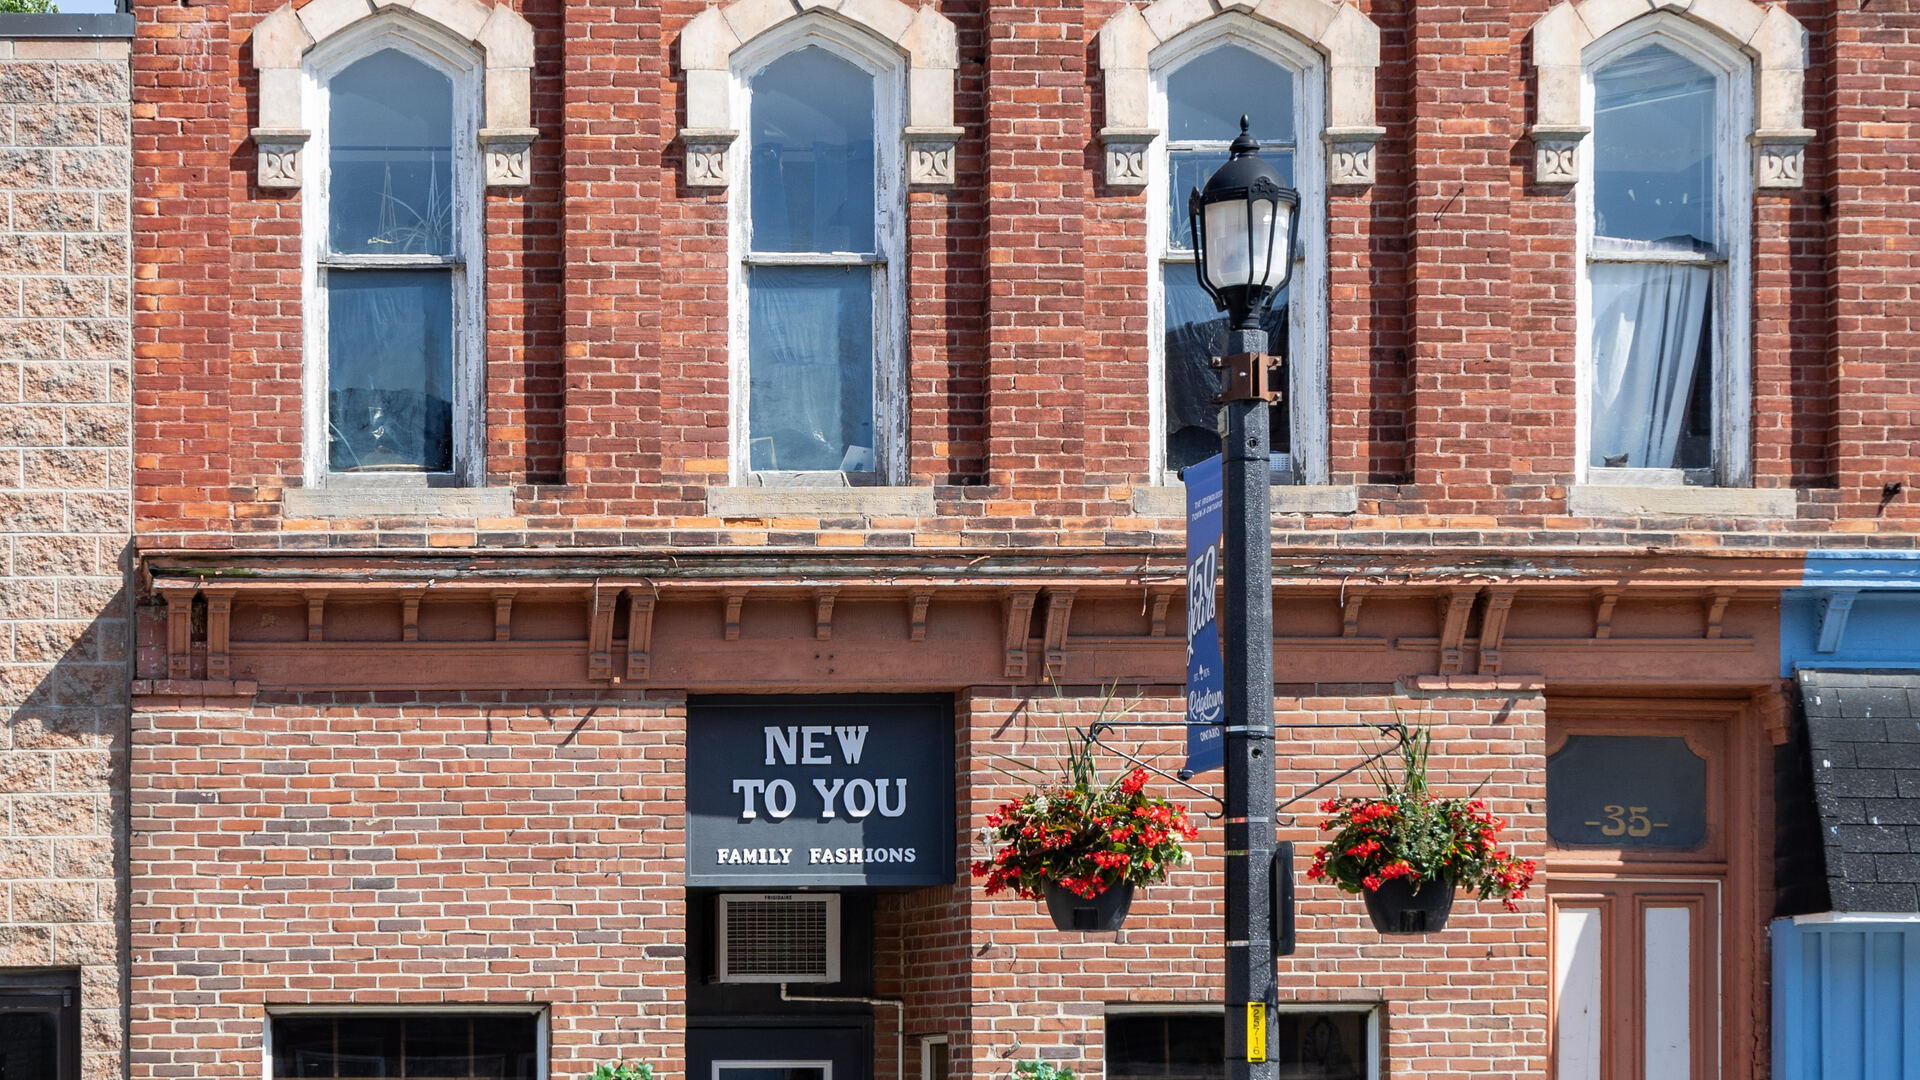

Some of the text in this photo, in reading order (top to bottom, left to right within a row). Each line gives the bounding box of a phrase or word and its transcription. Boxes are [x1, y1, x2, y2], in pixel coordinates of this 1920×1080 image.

[1187, 545, 1216, 614] 150
[764, 725, 869, 765] NEW
[732, 778, 907, 820] TO YOU
[717, 847, 916, 865] FAMILY FASHIONS
